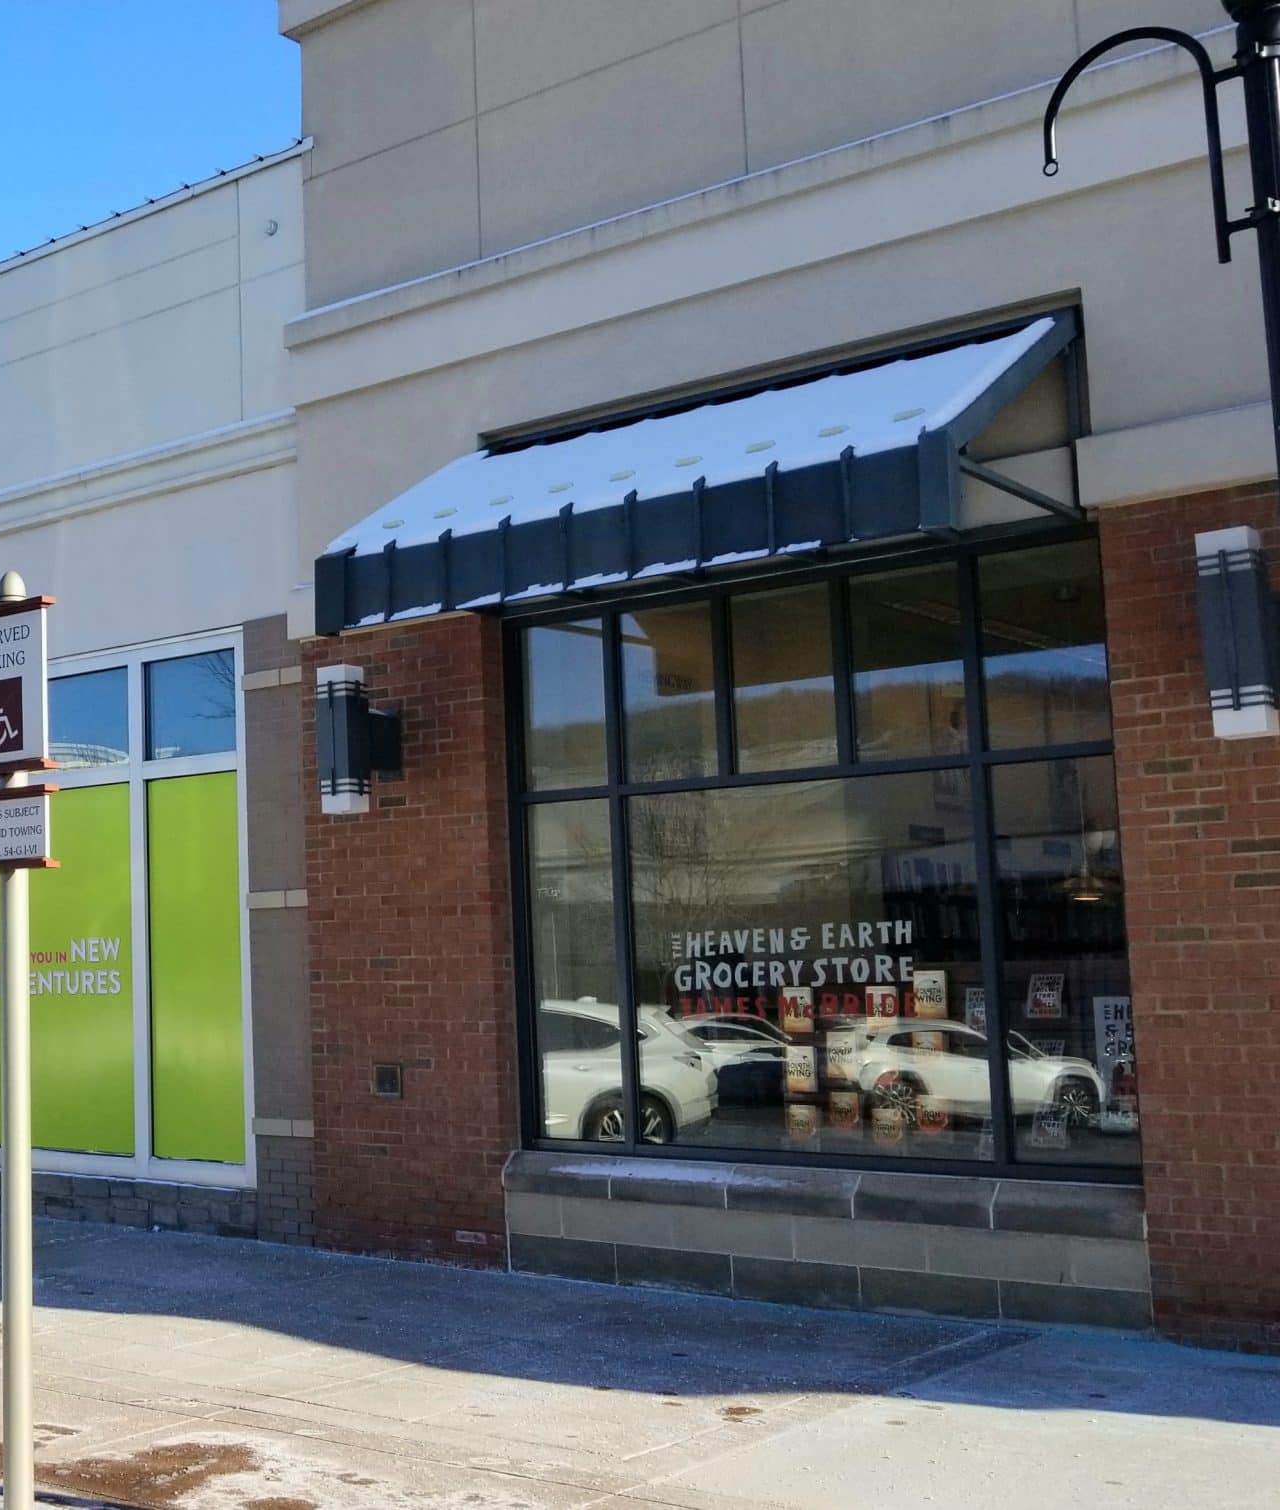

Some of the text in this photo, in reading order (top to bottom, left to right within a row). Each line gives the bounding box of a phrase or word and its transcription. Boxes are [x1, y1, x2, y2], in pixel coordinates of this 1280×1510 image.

[4, 805, 40, 818] SUBJECT
[8, 824, 42, 837] TOWING
[31, 937, 120, 964] YOU IN NEW
[672, 931, 682, 959] THE
[685, 928, 784, 958] HEAVEN
[822, 920, 912, 949] EARTH
[674, 954, 913, 992] GROCERY STORE
[679, 996, 767, 1021] JAMES
